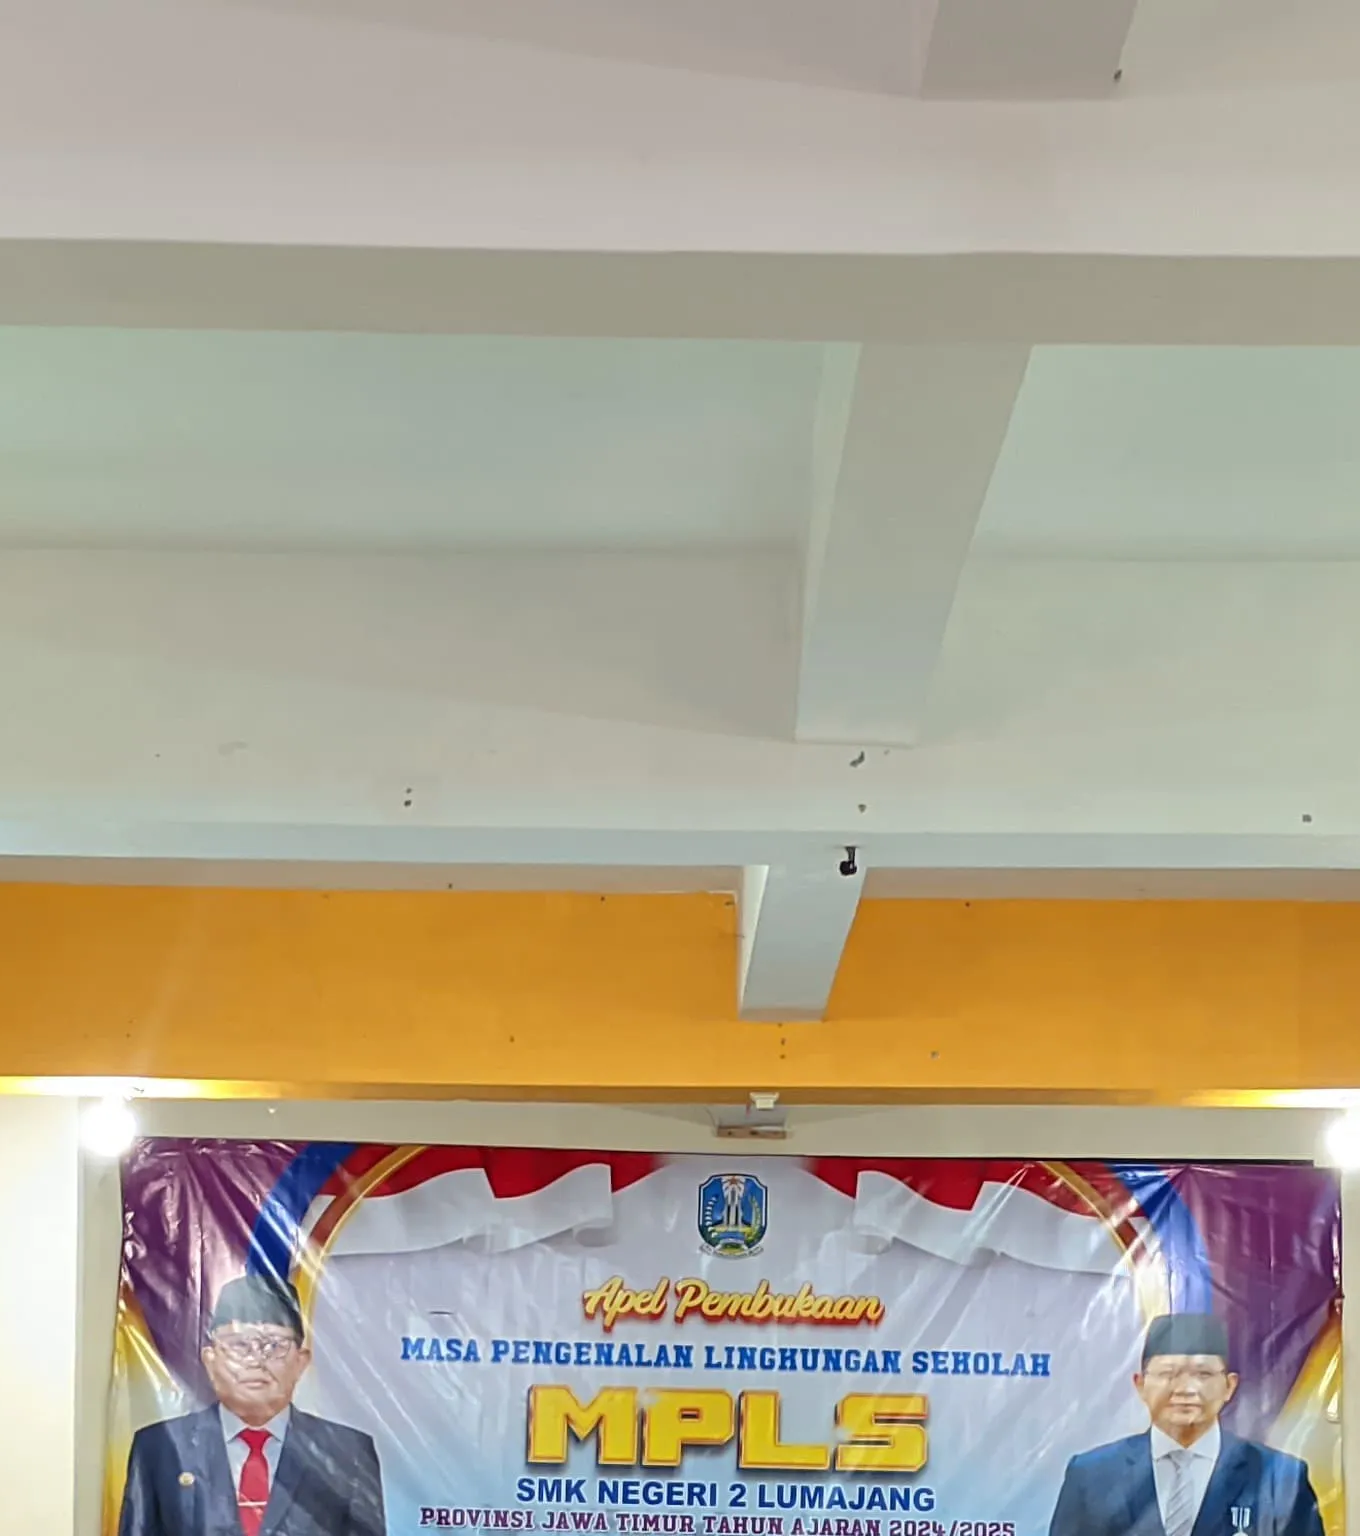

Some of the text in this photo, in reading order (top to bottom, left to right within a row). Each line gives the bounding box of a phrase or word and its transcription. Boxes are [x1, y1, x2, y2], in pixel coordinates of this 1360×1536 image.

[583, 1275, 885, 1332] Apel Pembukaan
[401, 1336, 481, 1363] MASA
[490, 1339, 694, 1369] PENGENALAN
[704, 1344, 901, 1374] LINGKUNGAN
[527, 1384, 929, 1472] MPLS
[517, 1478, 935, 1511] SMK NEGERI 2 LUMAJANG
[421, 1507, 534, 1529] PROVINSI
[542, 1511, 608, 1530] JAWA
[616, 1512, 695, 1533] TIMUR
[703, 1516, 783, 1536] TAHUN
